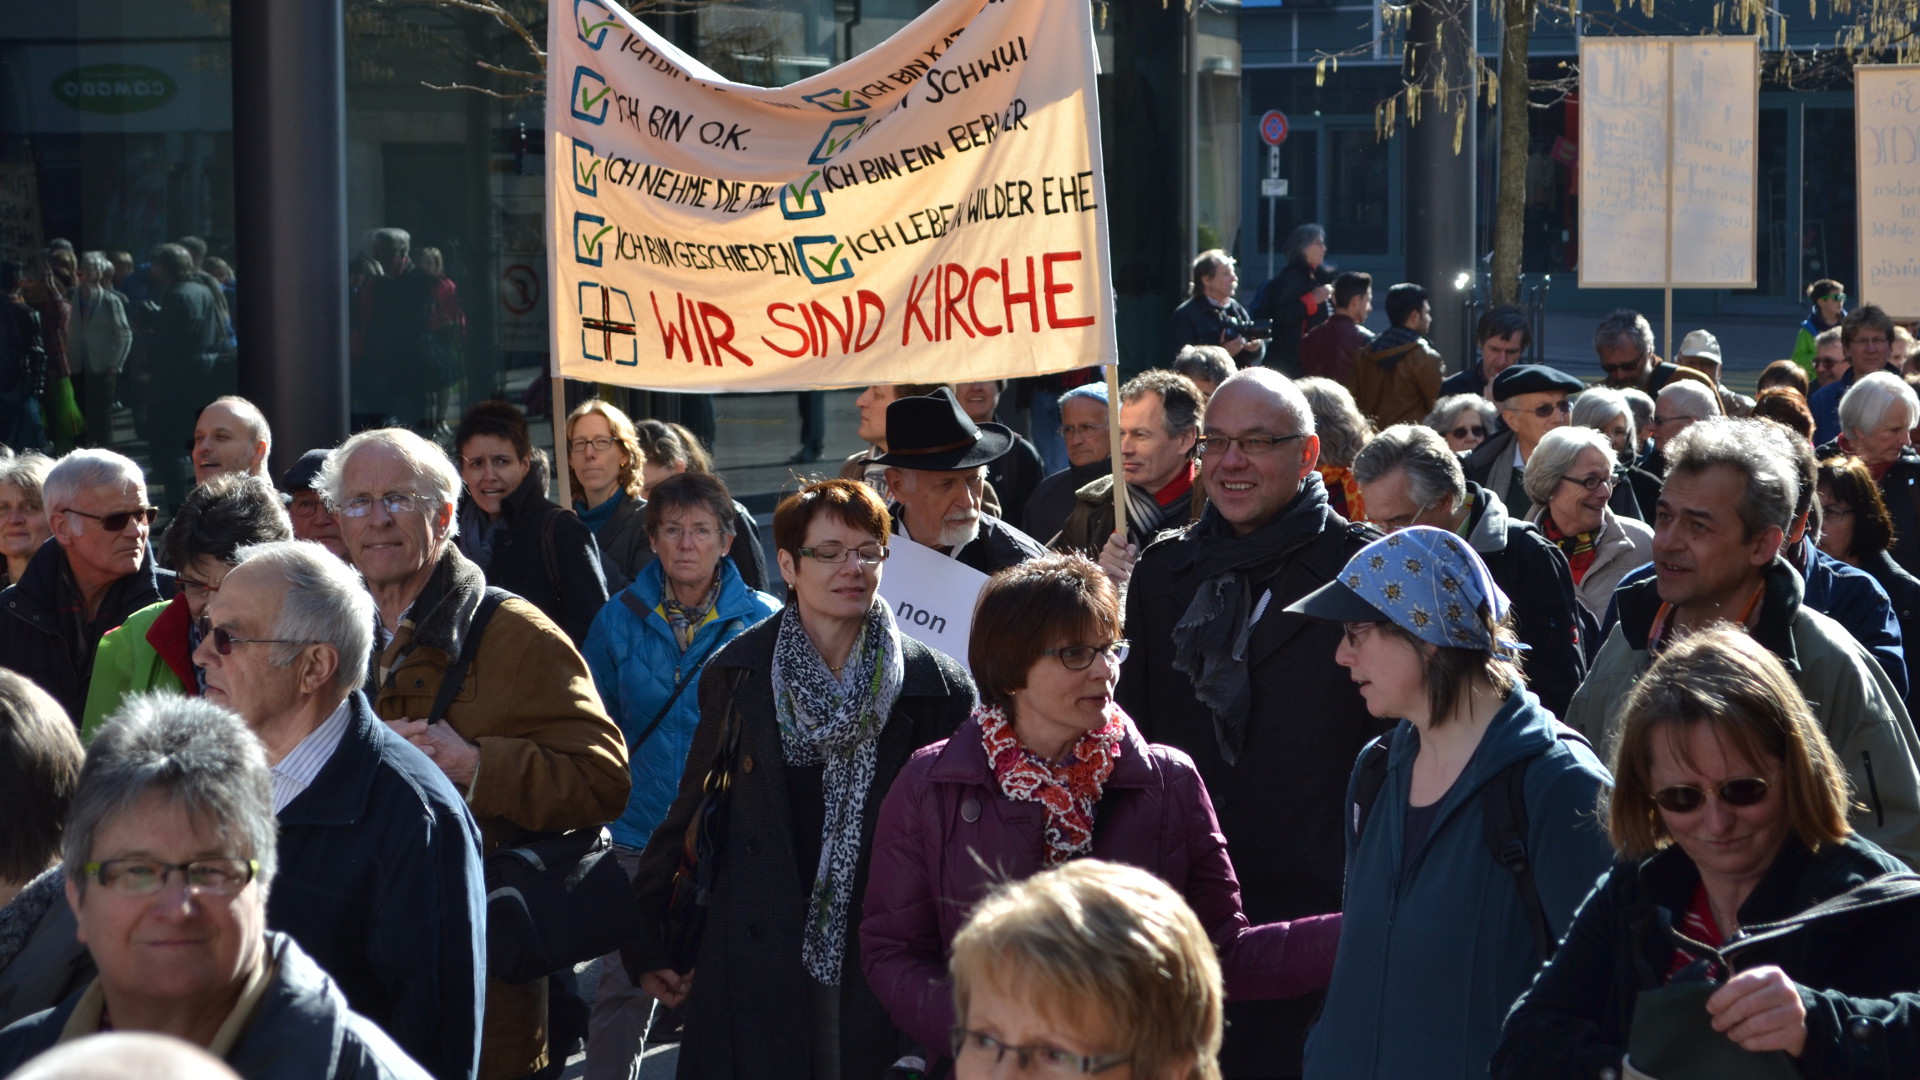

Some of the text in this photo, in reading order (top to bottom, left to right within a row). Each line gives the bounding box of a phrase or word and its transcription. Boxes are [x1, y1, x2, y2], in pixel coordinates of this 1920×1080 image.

[853, 80, 896, 99] ICH
[887, 59, 930, 85] BIN
[613, 89, 751, 151] ICH BIN O.K.
[604, 152, 640, 186] ICH
[637, 165, 712, 208] NEHME
[713, 179, 746, 213] DIE
[822, 164, 859, 193] ICH
[860, 153, 902, 184] BIN
[900, 141, 945, 173] EIN
[846, 225, 895, 260] ICH
[967, 180, 1035, 223] WILDER
[1042, 171, 1098, 215] EHE
[614, 226, 801, 276] ICH BIN GESCHIEDEN
[649, 250, 1096, 367] WIR SIND KIRCHE
[896, 601, 947, 634] non
